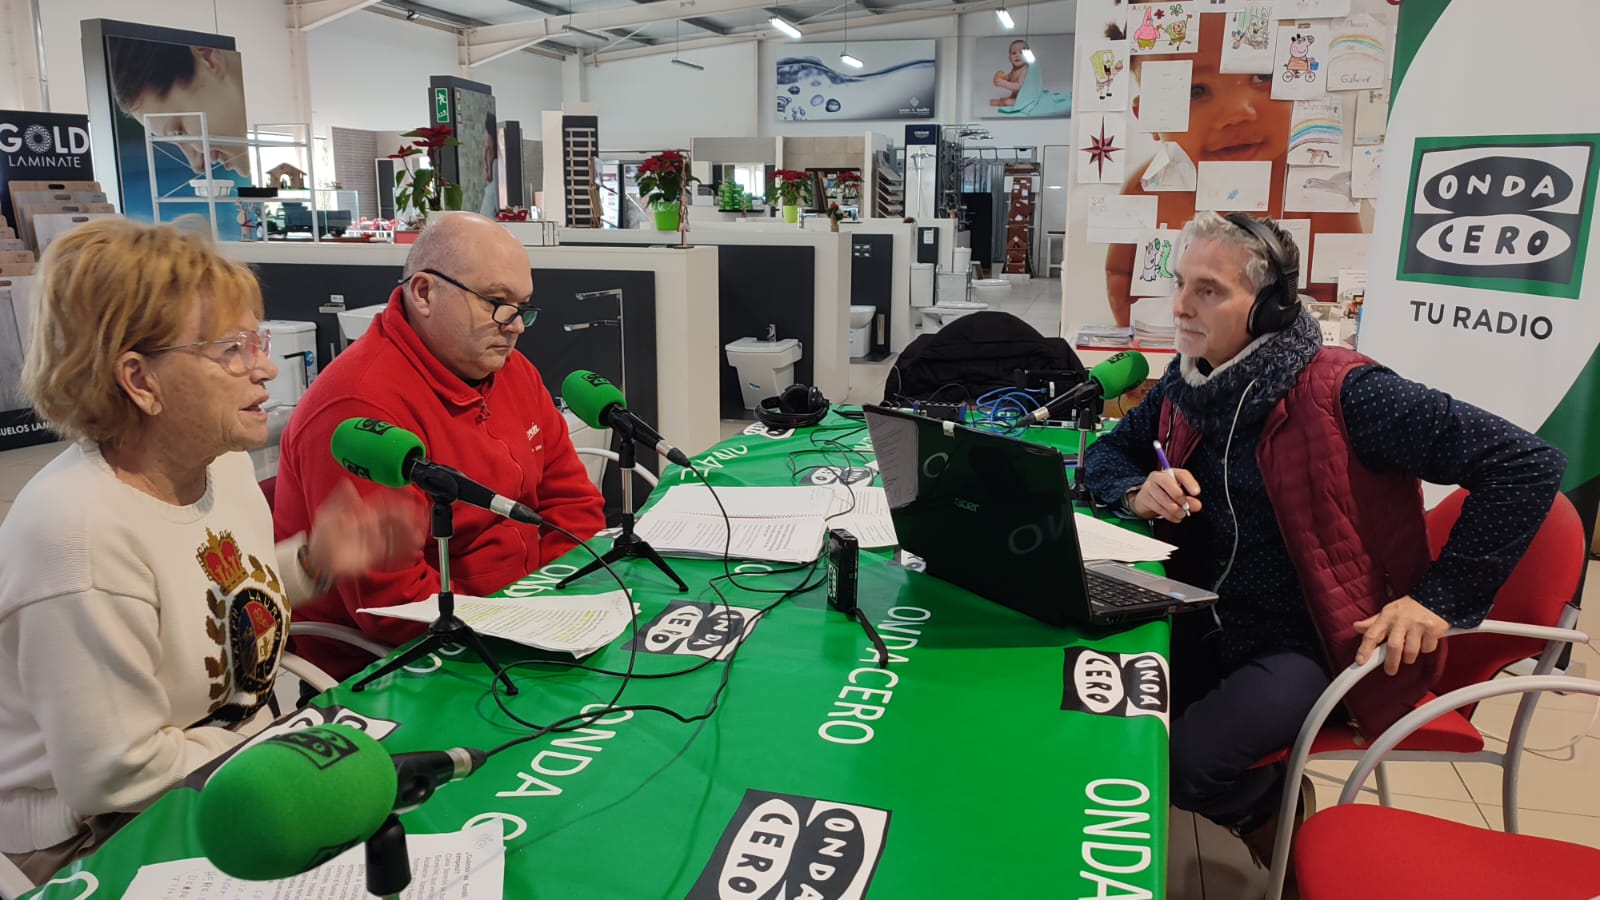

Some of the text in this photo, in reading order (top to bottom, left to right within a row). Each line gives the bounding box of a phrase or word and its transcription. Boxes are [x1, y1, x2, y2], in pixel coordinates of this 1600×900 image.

[0, 123, 89, 153] GOLD
[8, 155, 81, 168] LAMINATE
[1438, 173, 1555, 200] ONDA
[1438, 224, 1549, 256] CERO
[1410, 300, 1553, 340] TU RADIO
[0, 424, 30, 437] UELOS
[651, 612, 698, 644] CERO
[692, 614, 741, 645] ONDA
[858, 606, 931, 664] ONDA
[1085, 657, 1113, 705] CERO
[1134, 658, 1161, 707] ONDA
[818, 667, 899, 744] CERO
[495, 703, 634, 798] ONDA
[727, 812, 793, 895] CERO
[794, 817, 856, 900] ONDA
[1077, 778, 1153, 900] ONDA
